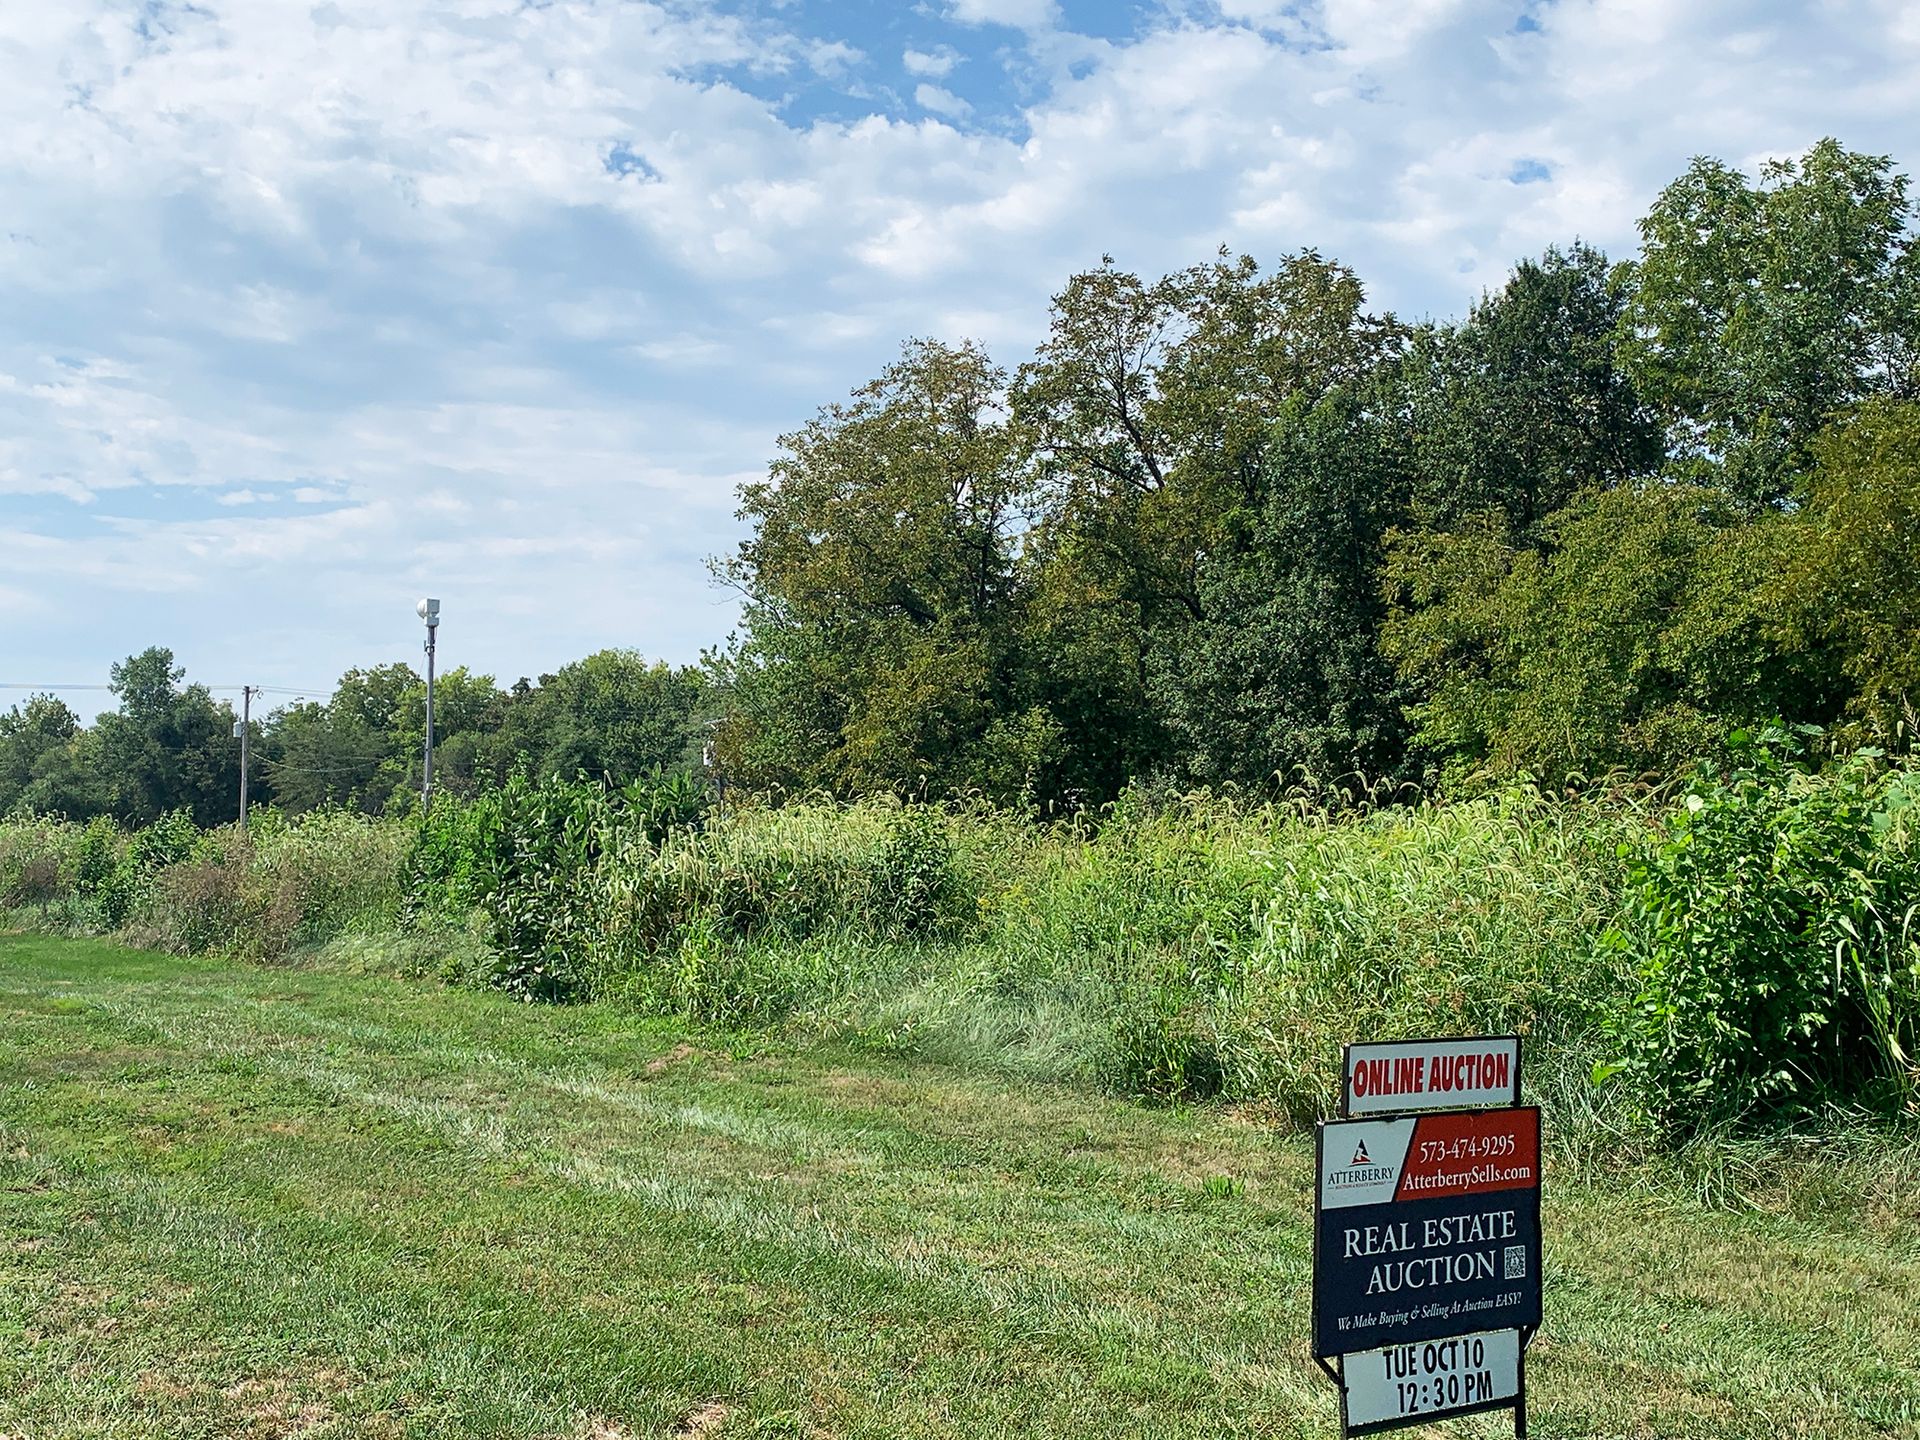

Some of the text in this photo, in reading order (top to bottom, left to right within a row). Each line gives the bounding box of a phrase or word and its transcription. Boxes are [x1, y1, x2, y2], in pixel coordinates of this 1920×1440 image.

[1353, 1053, 1509, 1098] ONLINE AUCTION
[1420, 1134, 1515, 1163] 573-474-9295
[1328, 1167, 1394, 1185] ATTERBERRY
[1403, 1165, 1530, 1191] AtterberrySells.com
[1344, 1210, 1517, 1258] REAL ESTATE
[1365, 1250, 1496, 1295] AUCTION
[1338, 1316, 1351, 1331] We
[1353, 1312, 1378, 1329] Make
[1379, 1308, 1409, 1328] Buying
[1410, 1305, 1420, 1320] &
[1421, 1302, 1449, 1320] Selling
[1450, 1300, 1461, 1315] At
[1462, 1297, 1494, 1312] Auction
[1383, 1338, 1484, 1380] TUE OCT 10
[1464, 1370, 1493, 1404] PM
